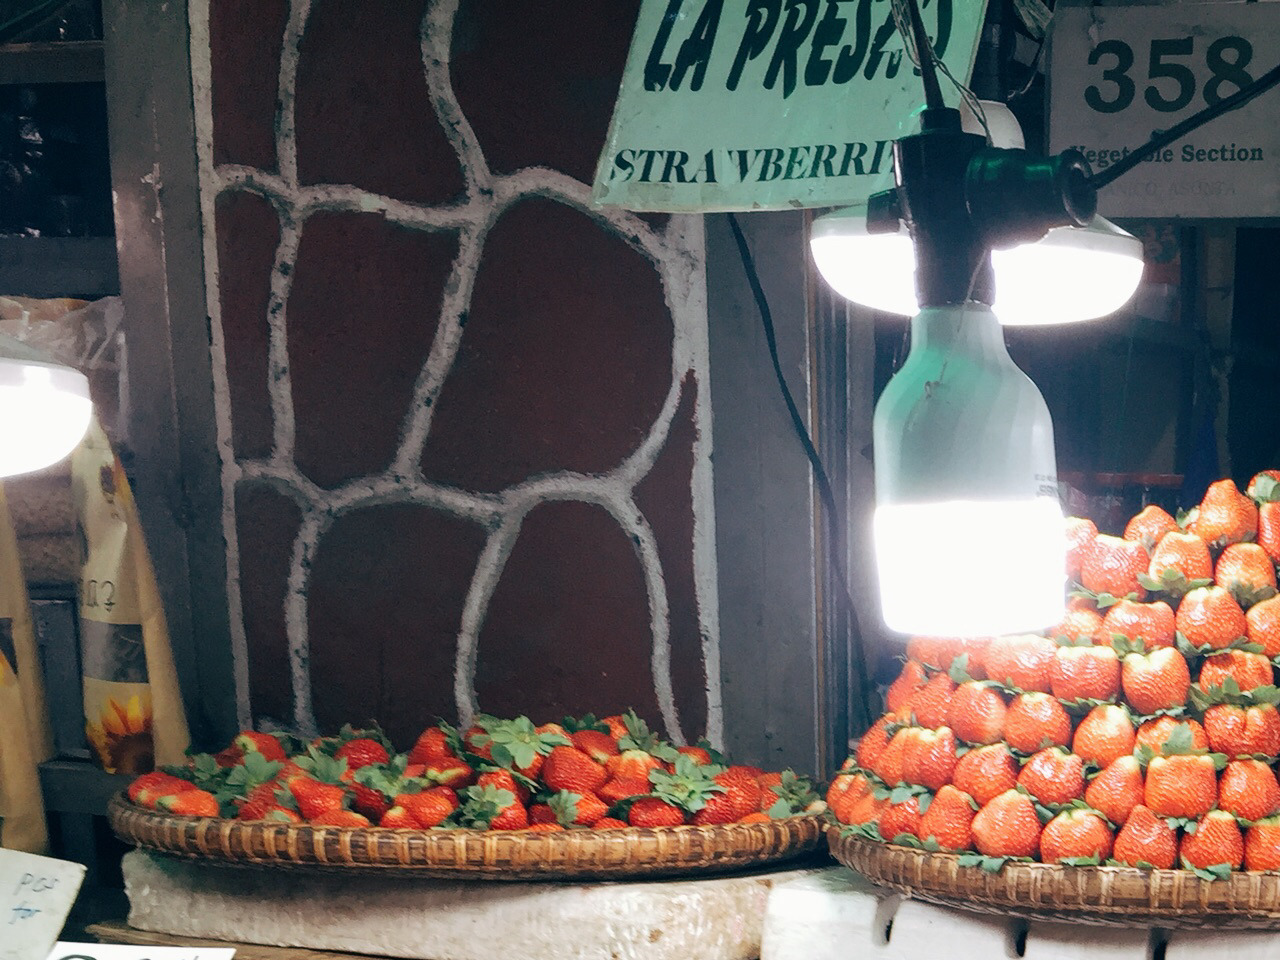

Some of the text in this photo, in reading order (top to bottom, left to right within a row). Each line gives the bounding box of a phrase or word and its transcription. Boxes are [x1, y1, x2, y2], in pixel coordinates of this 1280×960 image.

[644, 0, 724, 92] LA
[1084, 35, 1254, 113] 358
[611, 139, 895, 183] STRAWBERRI
[1070, 143, 1264, 168] egetble Section
